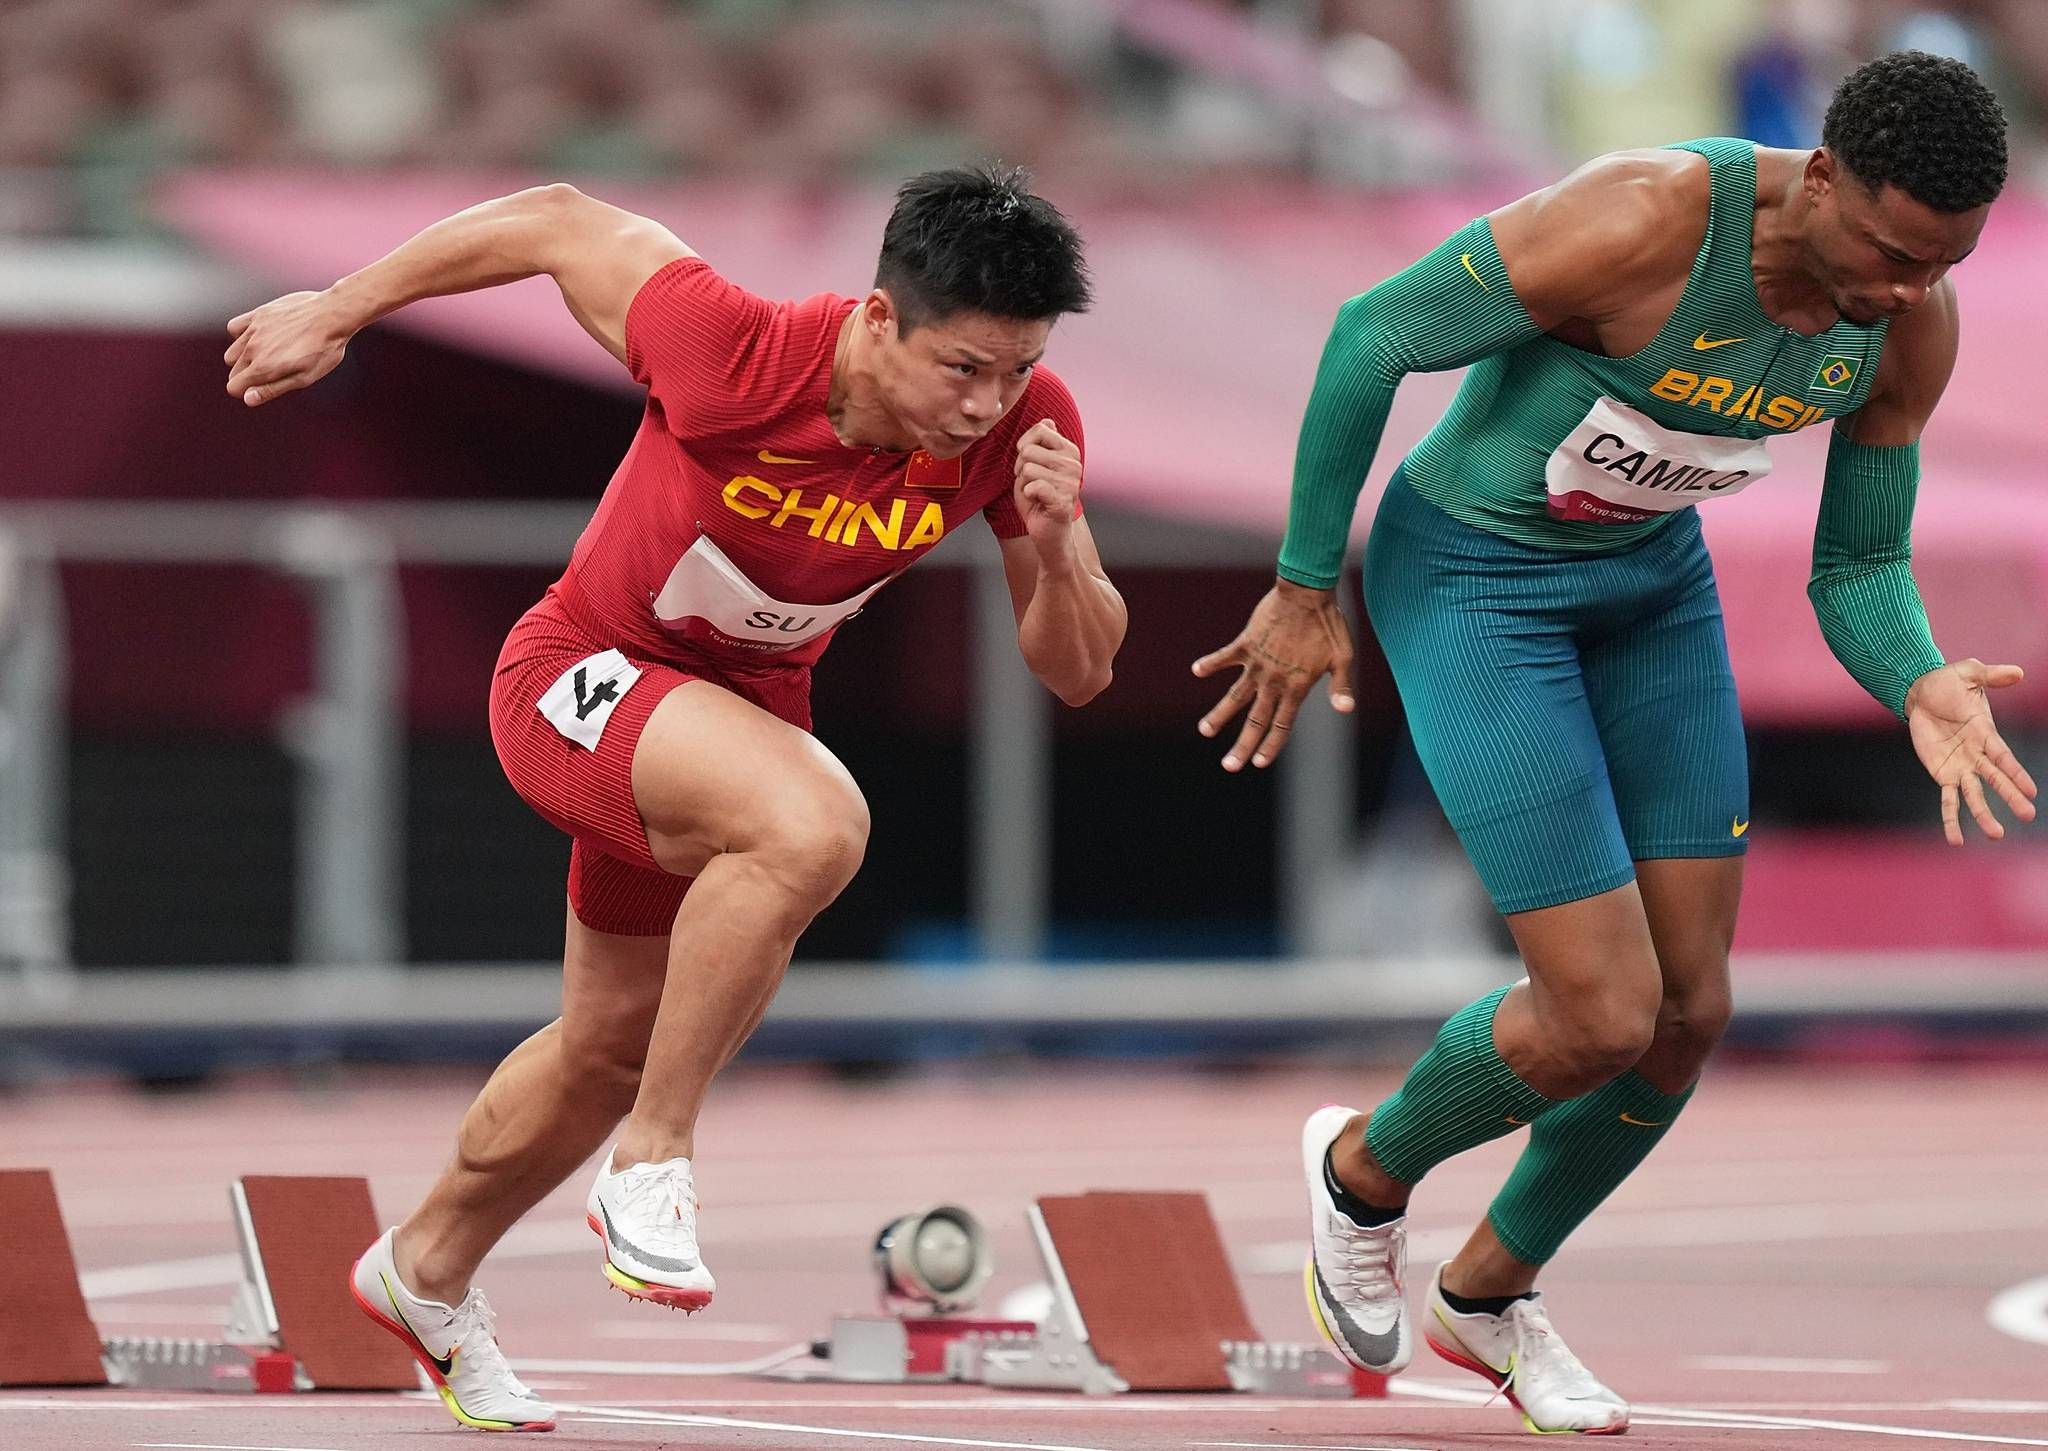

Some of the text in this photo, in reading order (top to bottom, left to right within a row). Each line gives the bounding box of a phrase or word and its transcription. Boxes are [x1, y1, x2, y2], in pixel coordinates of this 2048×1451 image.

[1583, 433, 1749, 492] CAMILO
[721, 475, 945, 551] CHINA
[1579, 500, 1632, 521] TOKYO 2020
[708, 630, 768, 651] TOKYO 2020
[745, 611, 817, 632] SU
[573, 667, 620, 722] 4
